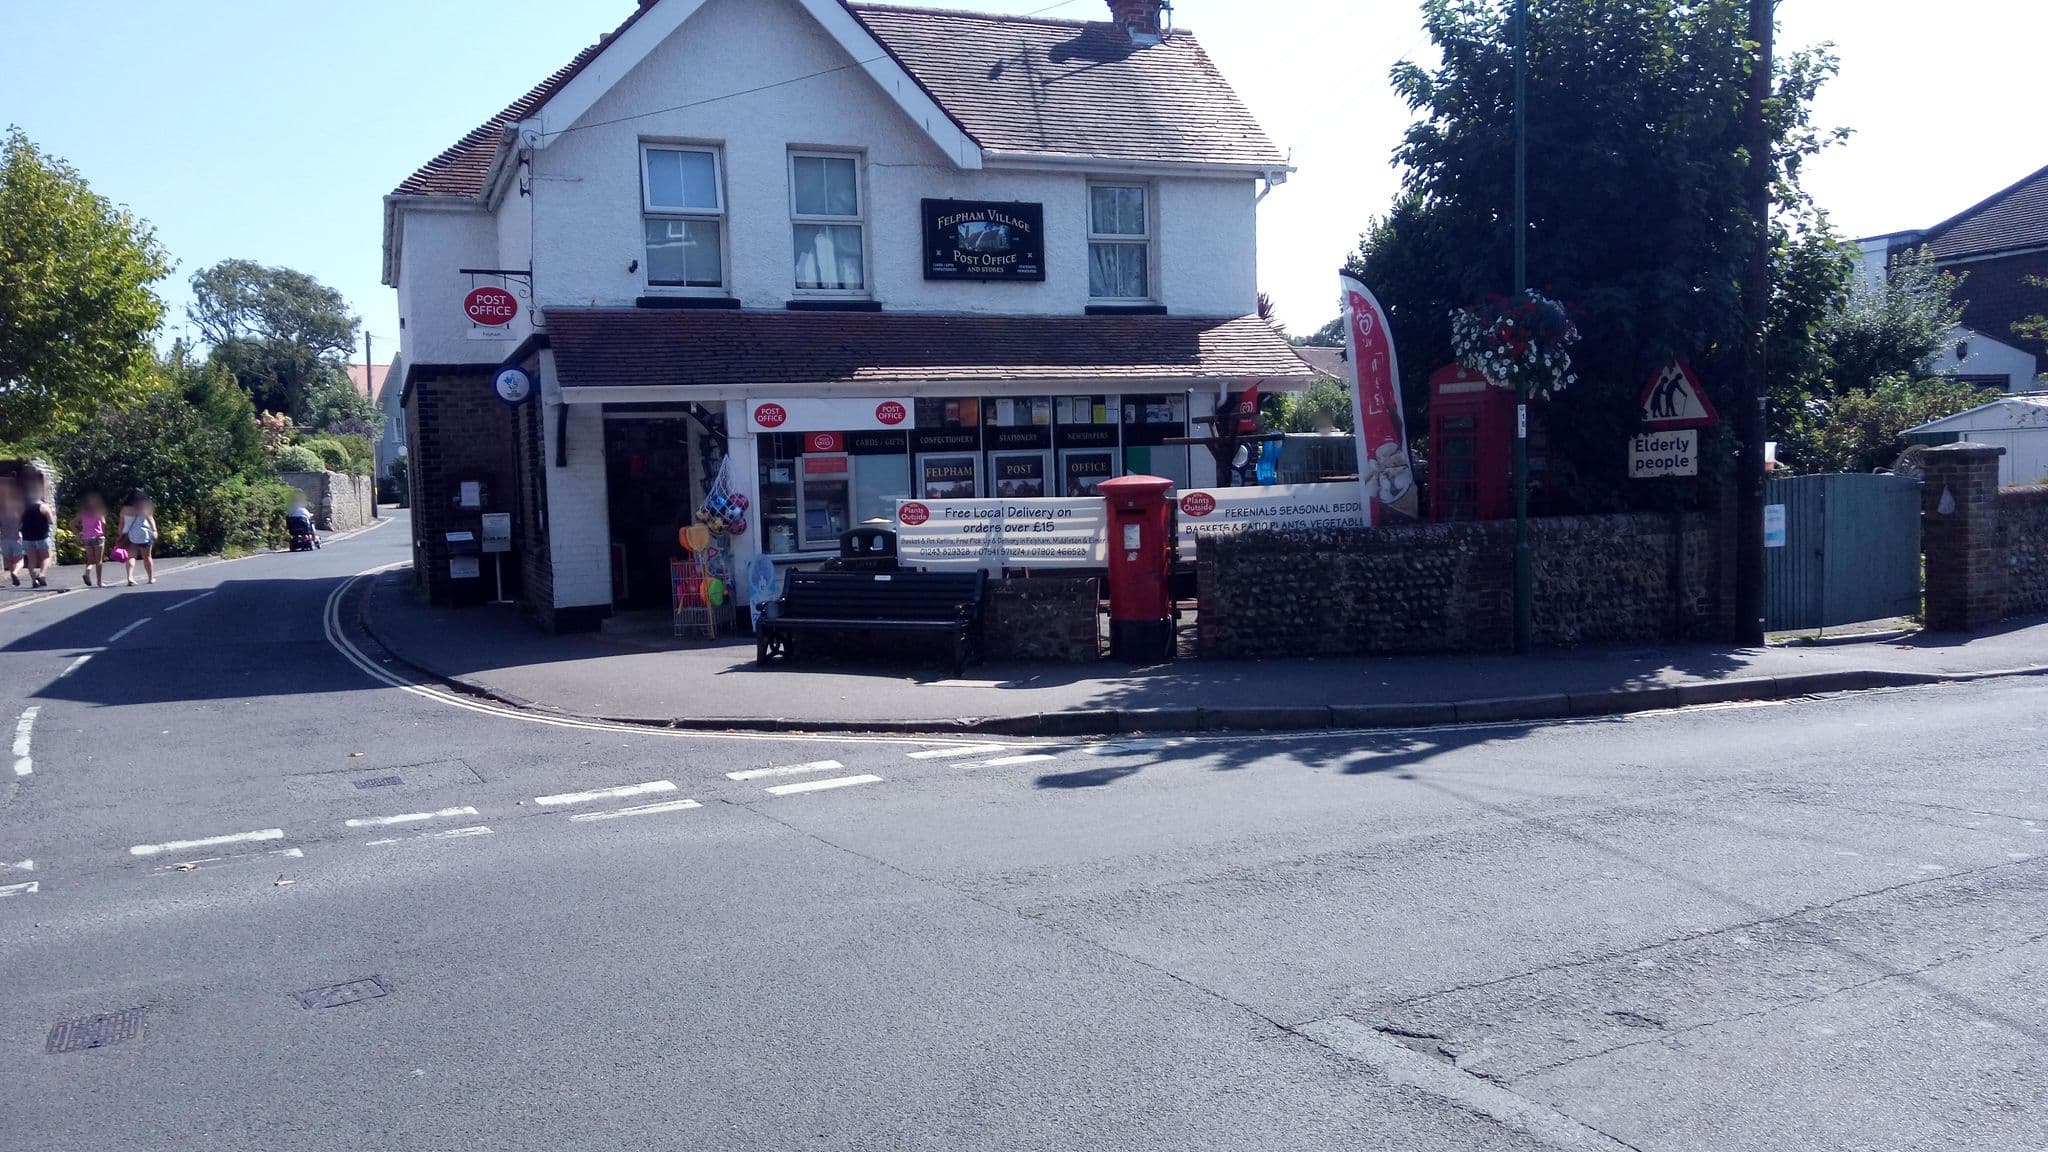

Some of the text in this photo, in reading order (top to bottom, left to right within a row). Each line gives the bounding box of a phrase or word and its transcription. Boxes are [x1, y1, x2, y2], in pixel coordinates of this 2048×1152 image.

[938, 209, 1030, 232] FELPHAM VILLAGE
[953, 249, 1017, 265] POST OFFICE
[476, 294, 507, 305] POST
[469, 305, 511, 316] OFFICE
[757, 414, 783, 422] OFFICE
[878, 412, 903, 420] OFFICE
[920, 435, 973, 444] CONFECTIONERY
[999, 433, 1037, 441] STATIONERY
[1066, 431, 1108, 440] NEWSPAPERS
[855, 438, 878, 447] CARDS
[1635, 437, 1689, 452] Elderly
[1072, 462, 1107, 473] OFFICE
[1636, 455, 1689, 471] people
[926, 466, 973, 478] FELPHAM
[1007, 464, 1033, 474] POST
[1186, 496, 1209, 504] Plants
[945, 506, 1072, 519] Free Local Delivery on
[1225, 502, 1362, 518] PERENIALS SEASONAL BEDDI
[963, 521, 1055, 533] orders over £15
[1185, 523, 1230, 534] BASKETS
[1232, 523, 1239, 532] &
[1241, 522, 1268, 531] PATIO
[1270, 520, 1306, 529] PLANTS
[919, 548, 941, 556] 01243
